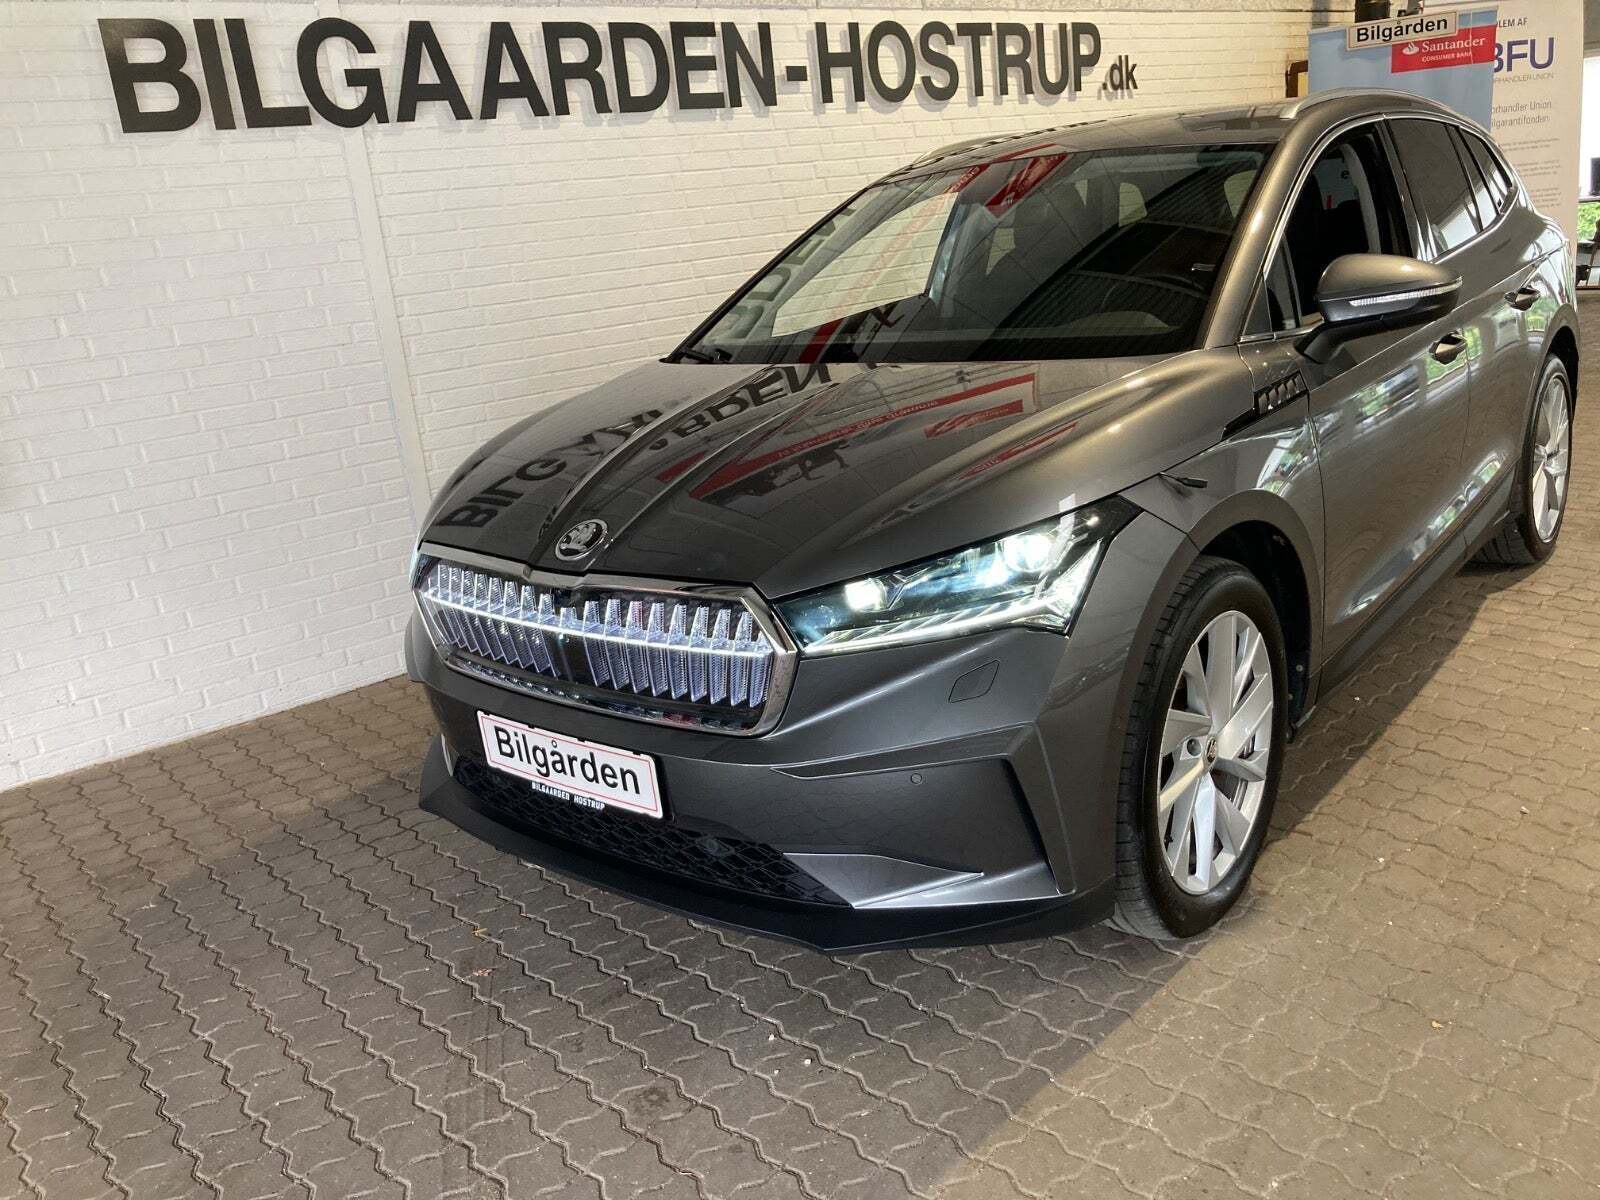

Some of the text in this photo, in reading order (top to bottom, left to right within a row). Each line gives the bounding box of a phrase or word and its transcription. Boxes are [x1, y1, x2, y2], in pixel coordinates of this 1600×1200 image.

[1517, 17, 1528, 26] AF
[1356, 18, 1448, 42] Bilgården
[1421, 37, 1486, 53] Santander
[1421, 53, 1455, 63] CONSUMER
[1492, 99, 1552, 114] orhandler Union
[494, 725, 641, 795] Bilgården
[531, 781, 606, 811] BILGAARDEN HOSTRUP
